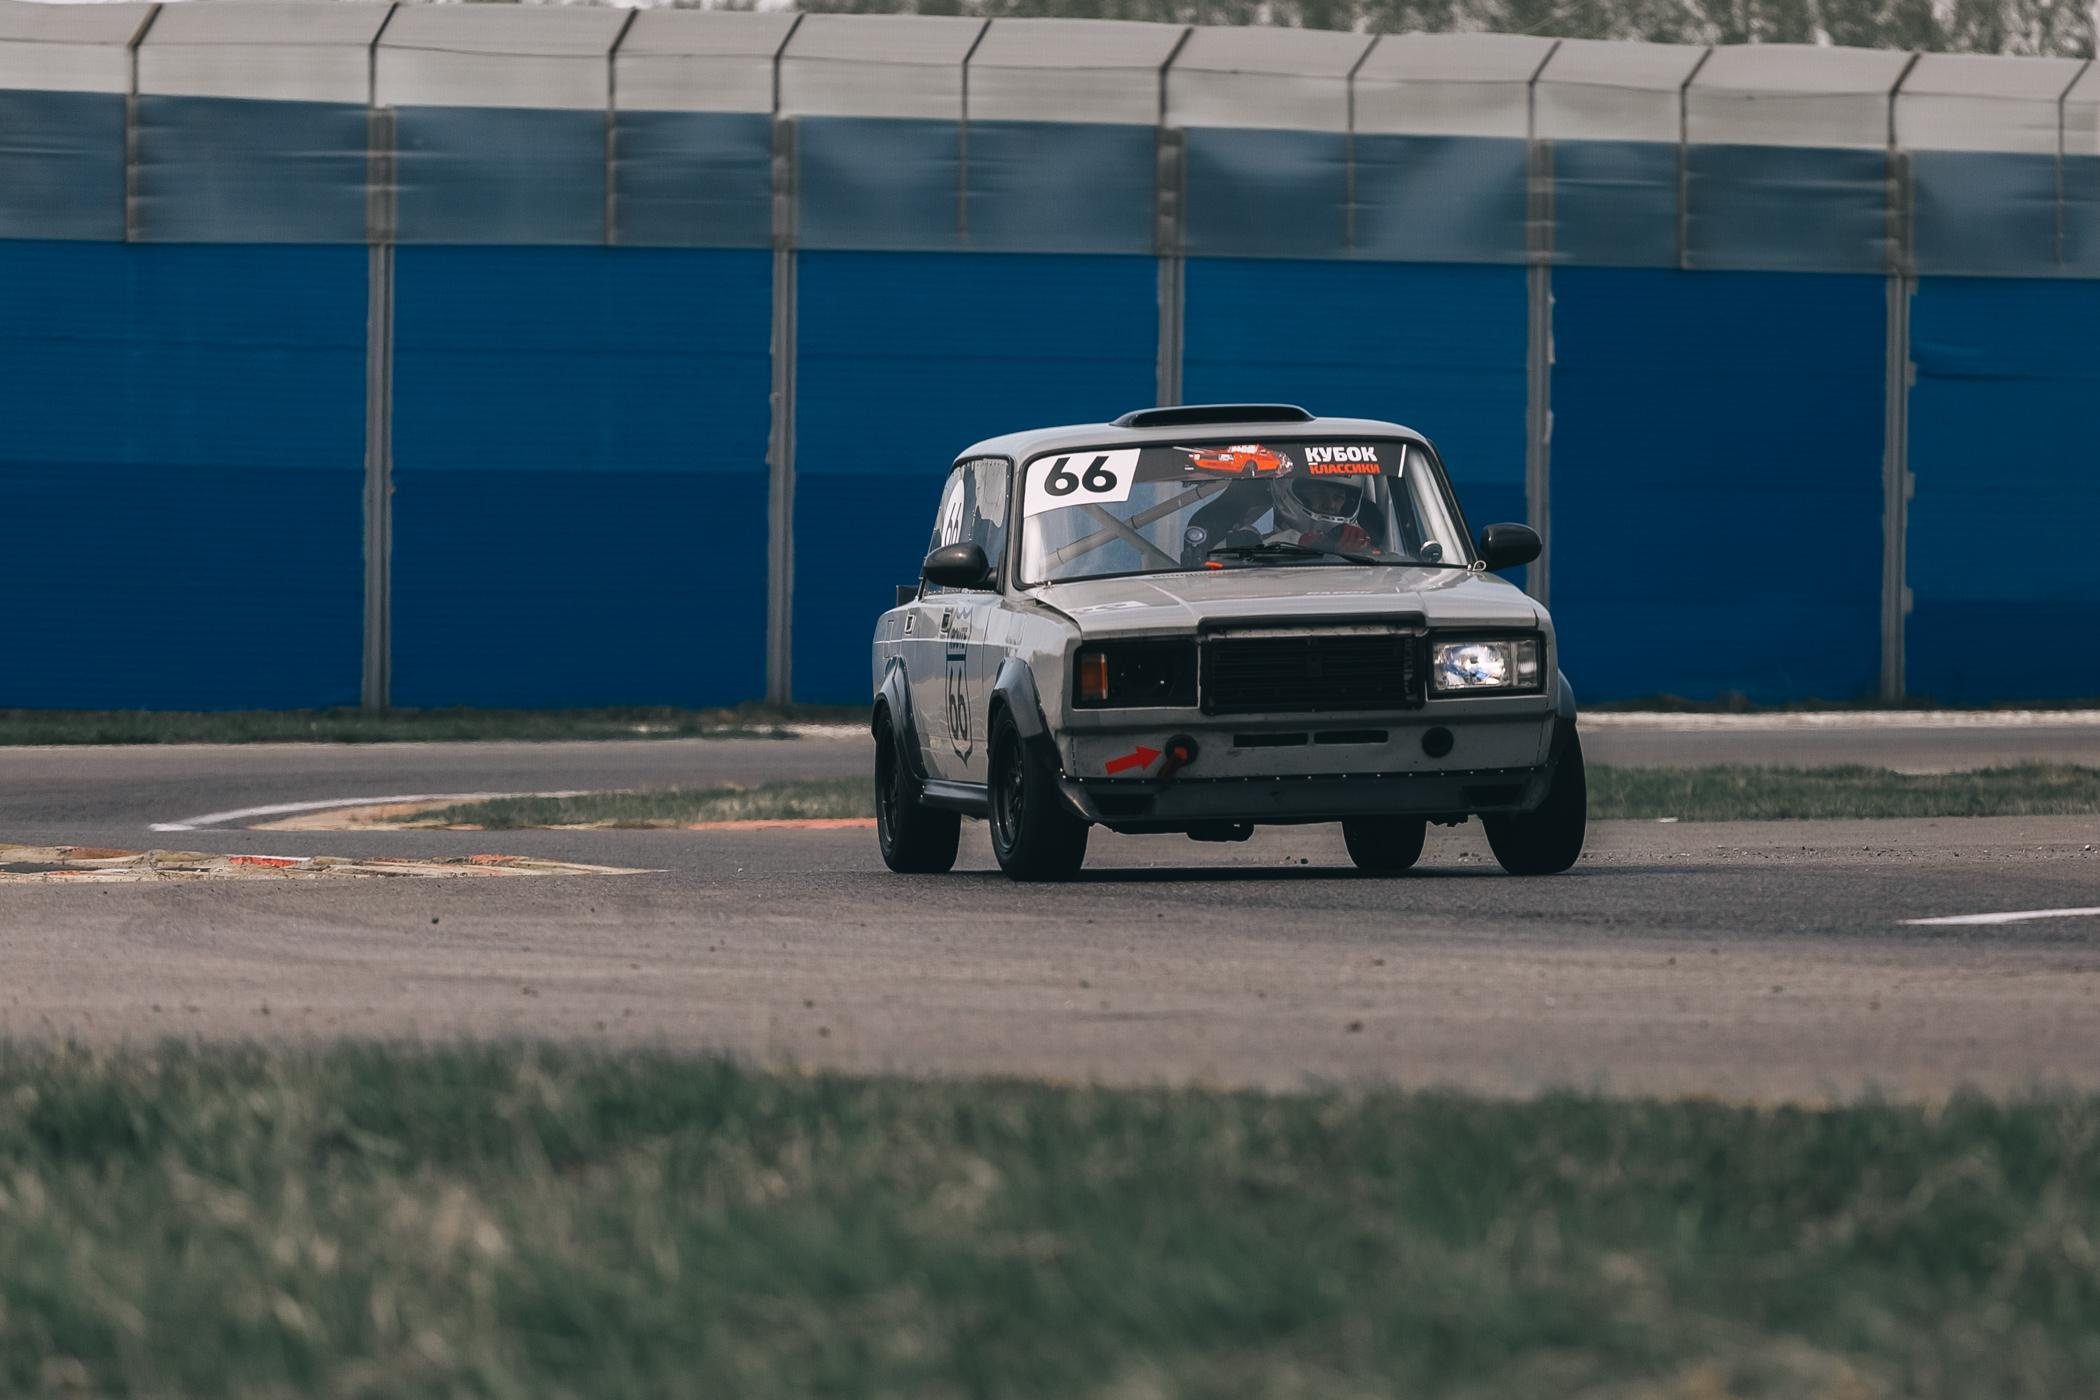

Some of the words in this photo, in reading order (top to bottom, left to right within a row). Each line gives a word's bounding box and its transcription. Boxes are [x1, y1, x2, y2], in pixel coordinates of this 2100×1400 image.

[1304, 447, 1378, 462] КУБОК
[1044, 456, 1118, 496] 66
[1309, 463, 1381, 474] КЛАССИКИ
[949, 666, 968, 741] 66
